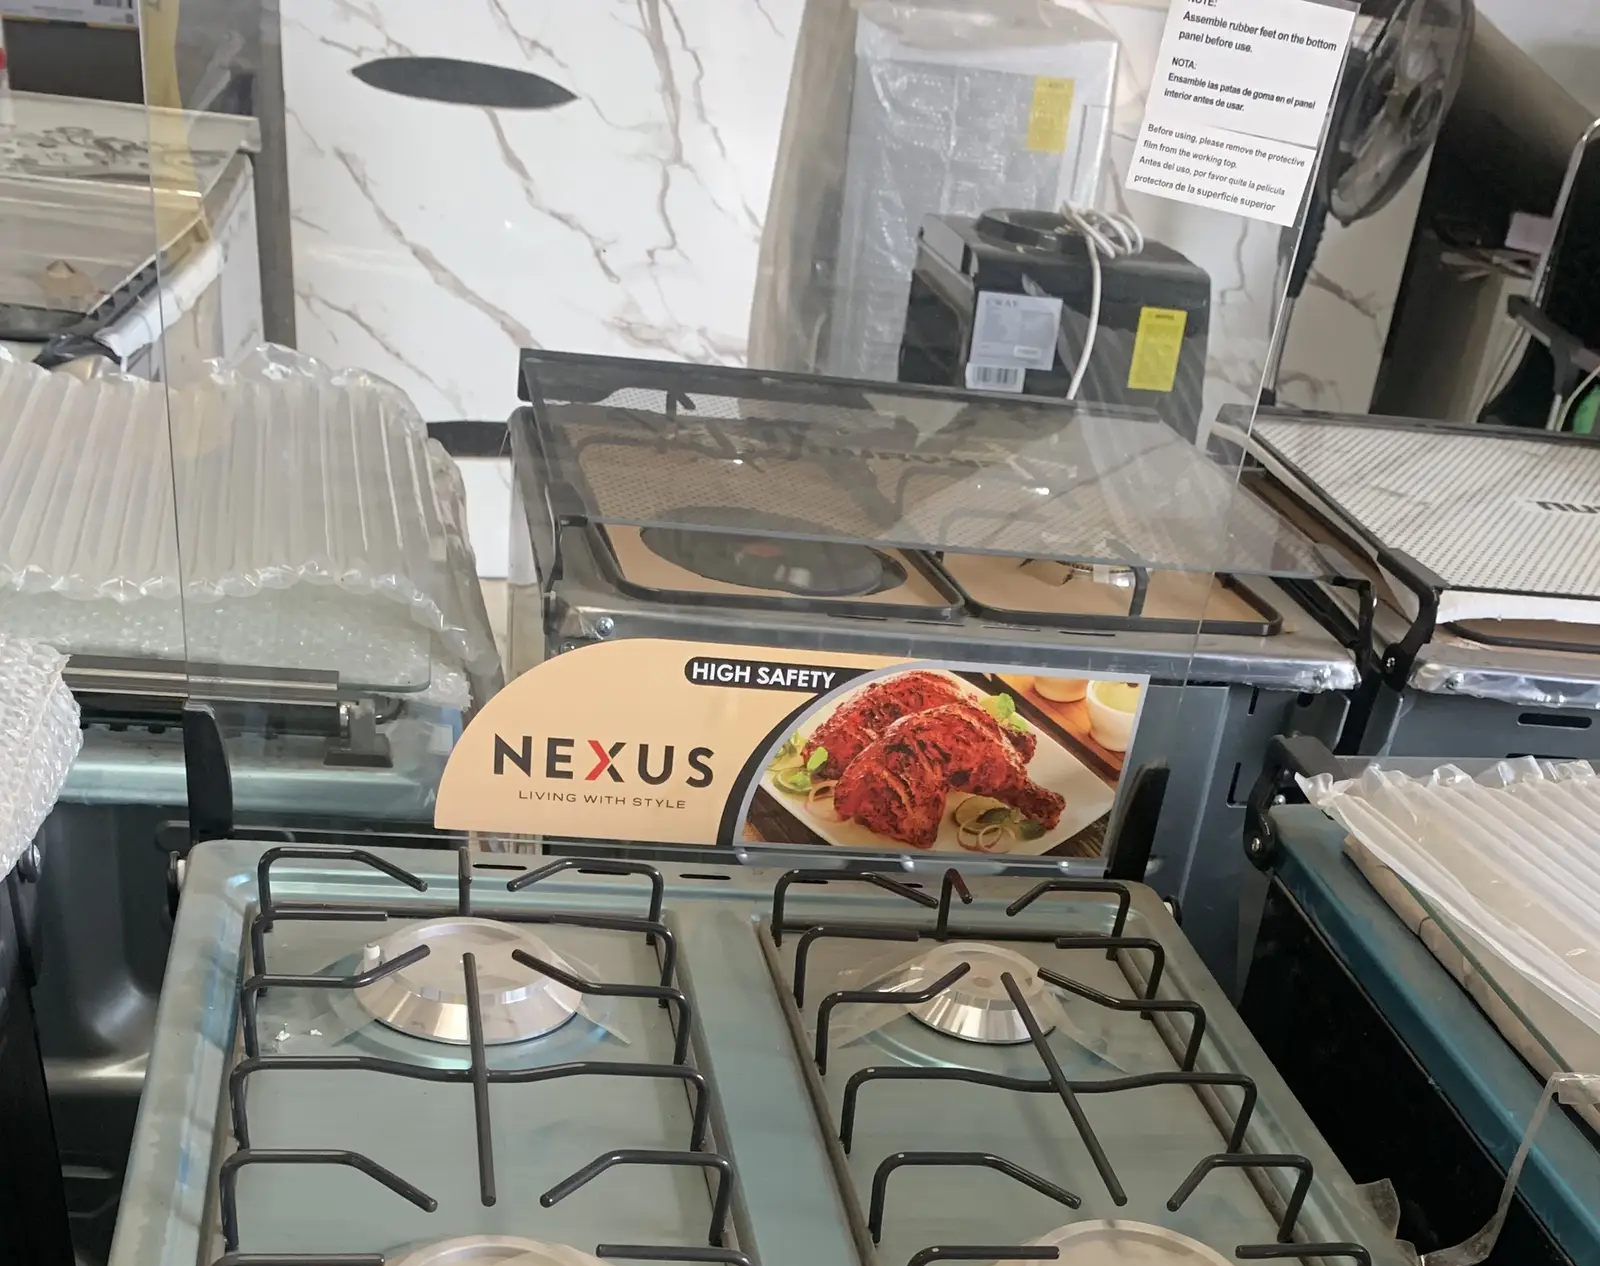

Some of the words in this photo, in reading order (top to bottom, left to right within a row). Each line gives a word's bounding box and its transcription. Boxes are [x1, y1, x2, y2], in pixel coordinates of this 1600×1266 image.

[1178, 31, 1204, 42] panel
[1205, 34, 1233, 49] before
[1235, 42, 1253, 53] use.
[1183, 11, 1228, 28] Assemble
[1229, 21, 1259, 35] rubber
[1260, 26, 1277, 39] feet
[1278, 32, 1289, 41] on
[1291, 32, 1304, 44] the
[1306, 36, 1337, 51] bottom
[1168, 72, 1206, 87] Ensamble
[1207, 80, 1219, 90] las
[1220, 84, 1241, 95] patas
[1242, 87, 1252, 97] de
[1252, 91, 1275, 101] goma
[1275, 95, 1285, 103] en
[1294, 99, 1316, 109] panel
[1193, 95, 1214, 105] antes
[1215, 98, 1225, 107] de
[1226, 101, 1245, 111] usar.
[1143, 139, 1158, 150] film
[1160, 143, 1178, 155] from
[1179, 148, 1191, 157] the
[1192, 152, 1223, 166] working
[1224, 158, 1238, 168] top.
[1147, 123, 1174, 137] Before
[1199, 136, 1225, 149] please
[1226, 143, 1254, 155] remove
[1255, 149, 1267, 158] the
[1268, 153, 1305, 167] protective
[1139, 156, 1161, 167] Antes
[1163, 161, 1175, 170] del
[1176, 166, 1192, 175] uso,
[1193, 169, 1208, 177] por
[1208, 171, 1228, 182] favor
[1228, 177, 1248, 187] quite
[1248, 180, 1256, 189] la
[1134, 174, 1174, 189] protectora
[1175, 182, 1186, 191] de
[1187, 184, 1196, 193] la
[1196, 188, 1239, 204] superficie
[1240, 197, 1276, 211] superior
[692, 662, 751, 683] HIGH
[756, 666, 836, 689] SAFETY
[493, 733, 715, 788] NEXUS
[518, 790, 577, 803] LIVING
[583, 795, 626, 806] WITH
[632, 797, 686, 809] STYLE
